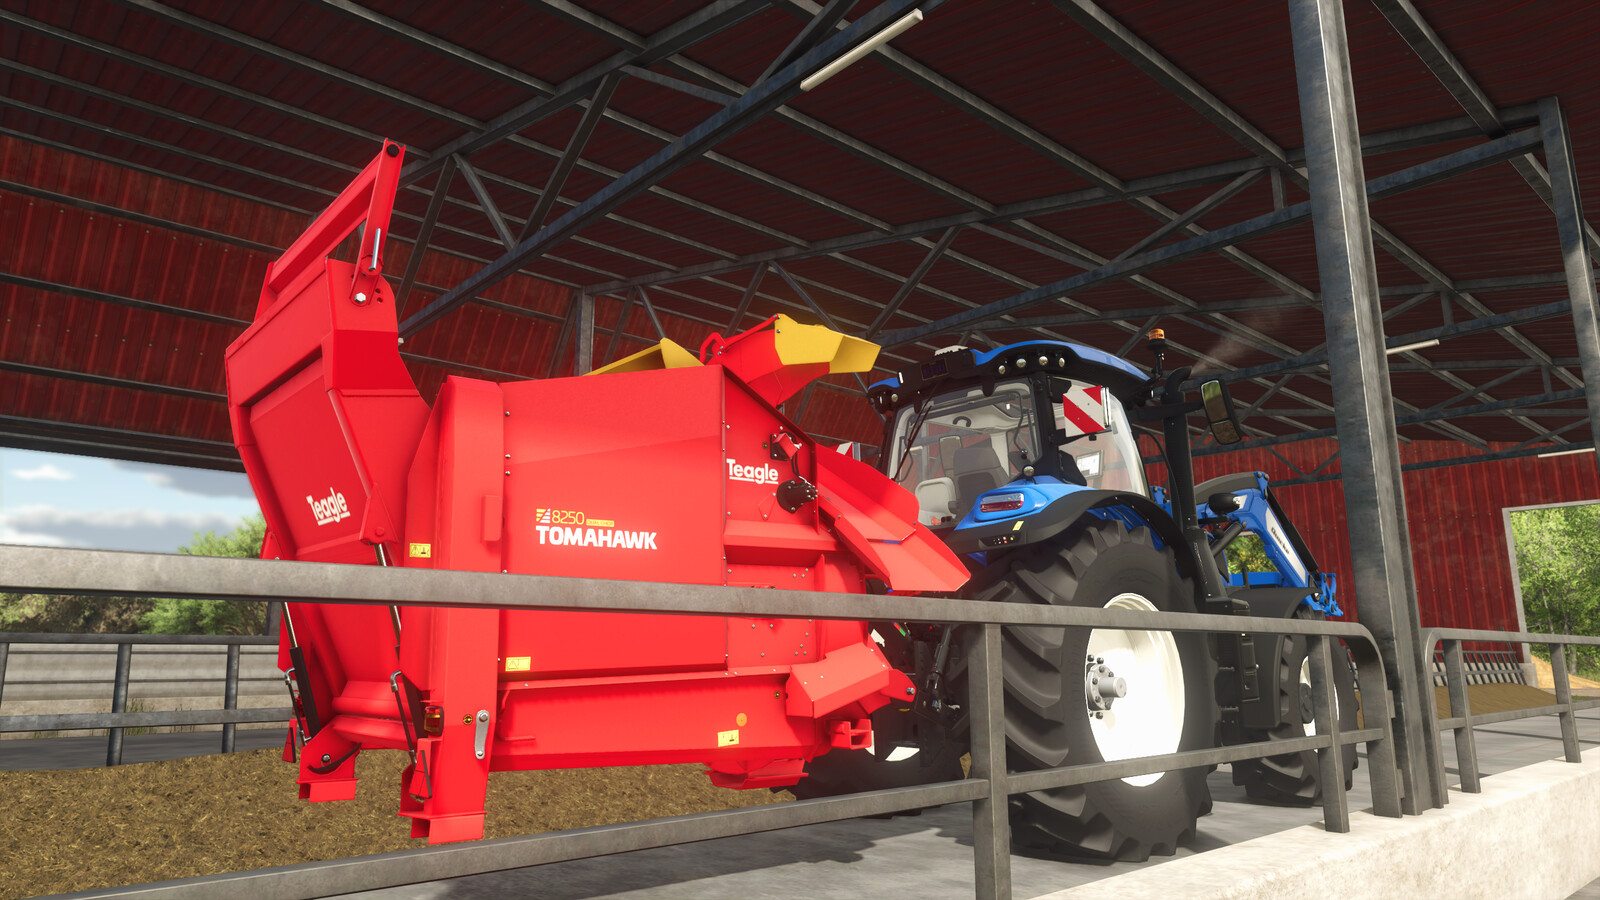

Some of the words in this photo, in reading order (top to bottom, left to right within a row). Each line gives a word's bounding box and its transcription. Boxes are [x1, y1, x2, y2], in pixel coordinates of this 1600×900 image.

[726, 458, 778, 485] Teagle
[306, 486, 349, 524] Teagle
[551, 509, 585, 525] 8250
[535, 525, 658, 550] TOMAHAWK
